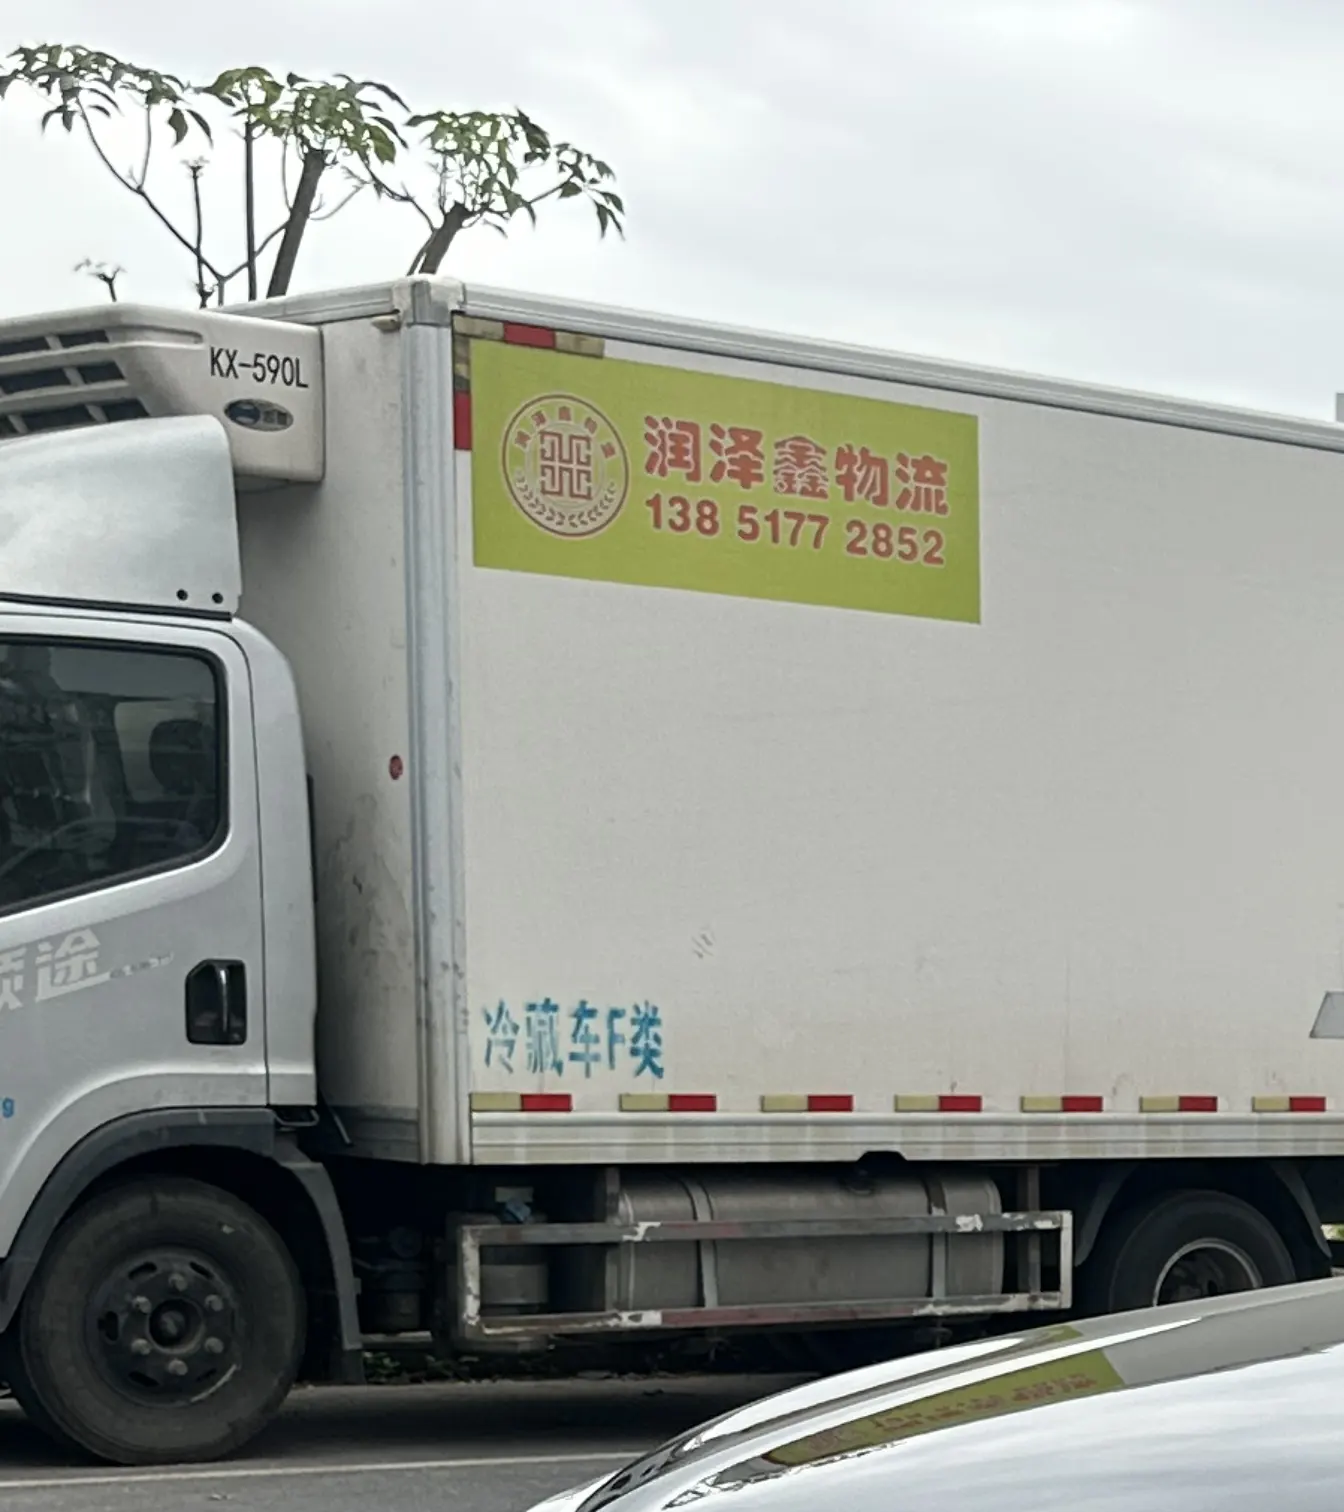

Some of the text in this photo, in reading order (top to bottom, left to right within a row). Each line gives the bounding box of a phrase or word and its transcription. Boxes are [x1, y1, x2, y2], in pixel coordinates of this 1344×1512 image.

[210, 346, 309, 388] KX-590L
[643, 414, 951, 517] 润泽鑫物流
[645, 493, 945, 566] 138 5177 2852
